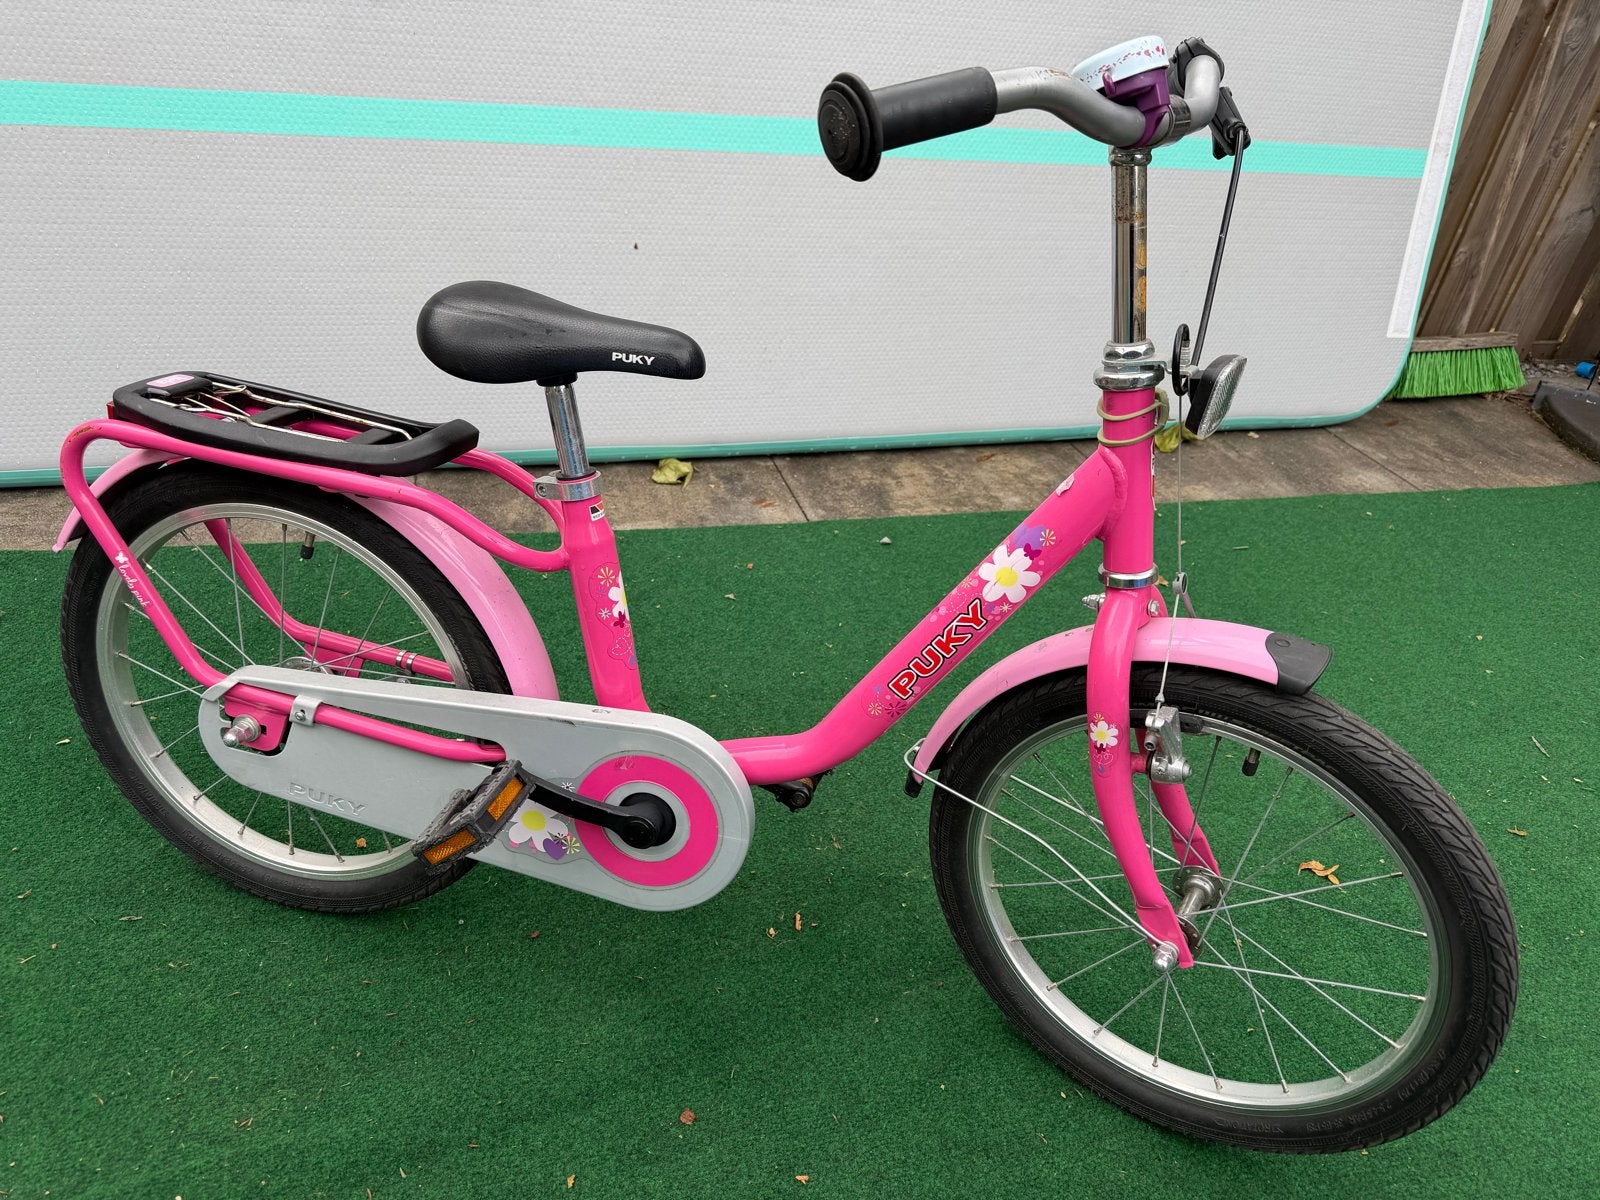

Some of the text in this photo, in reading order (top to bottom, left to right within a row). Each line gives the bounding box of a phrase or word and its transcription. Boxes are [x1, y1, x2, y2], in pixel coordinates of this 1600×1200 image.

[611, 351, 655, 366] PUKY
[887, 597, 988, 700] PUKY
[288, 781, 366, 816] PUKY
